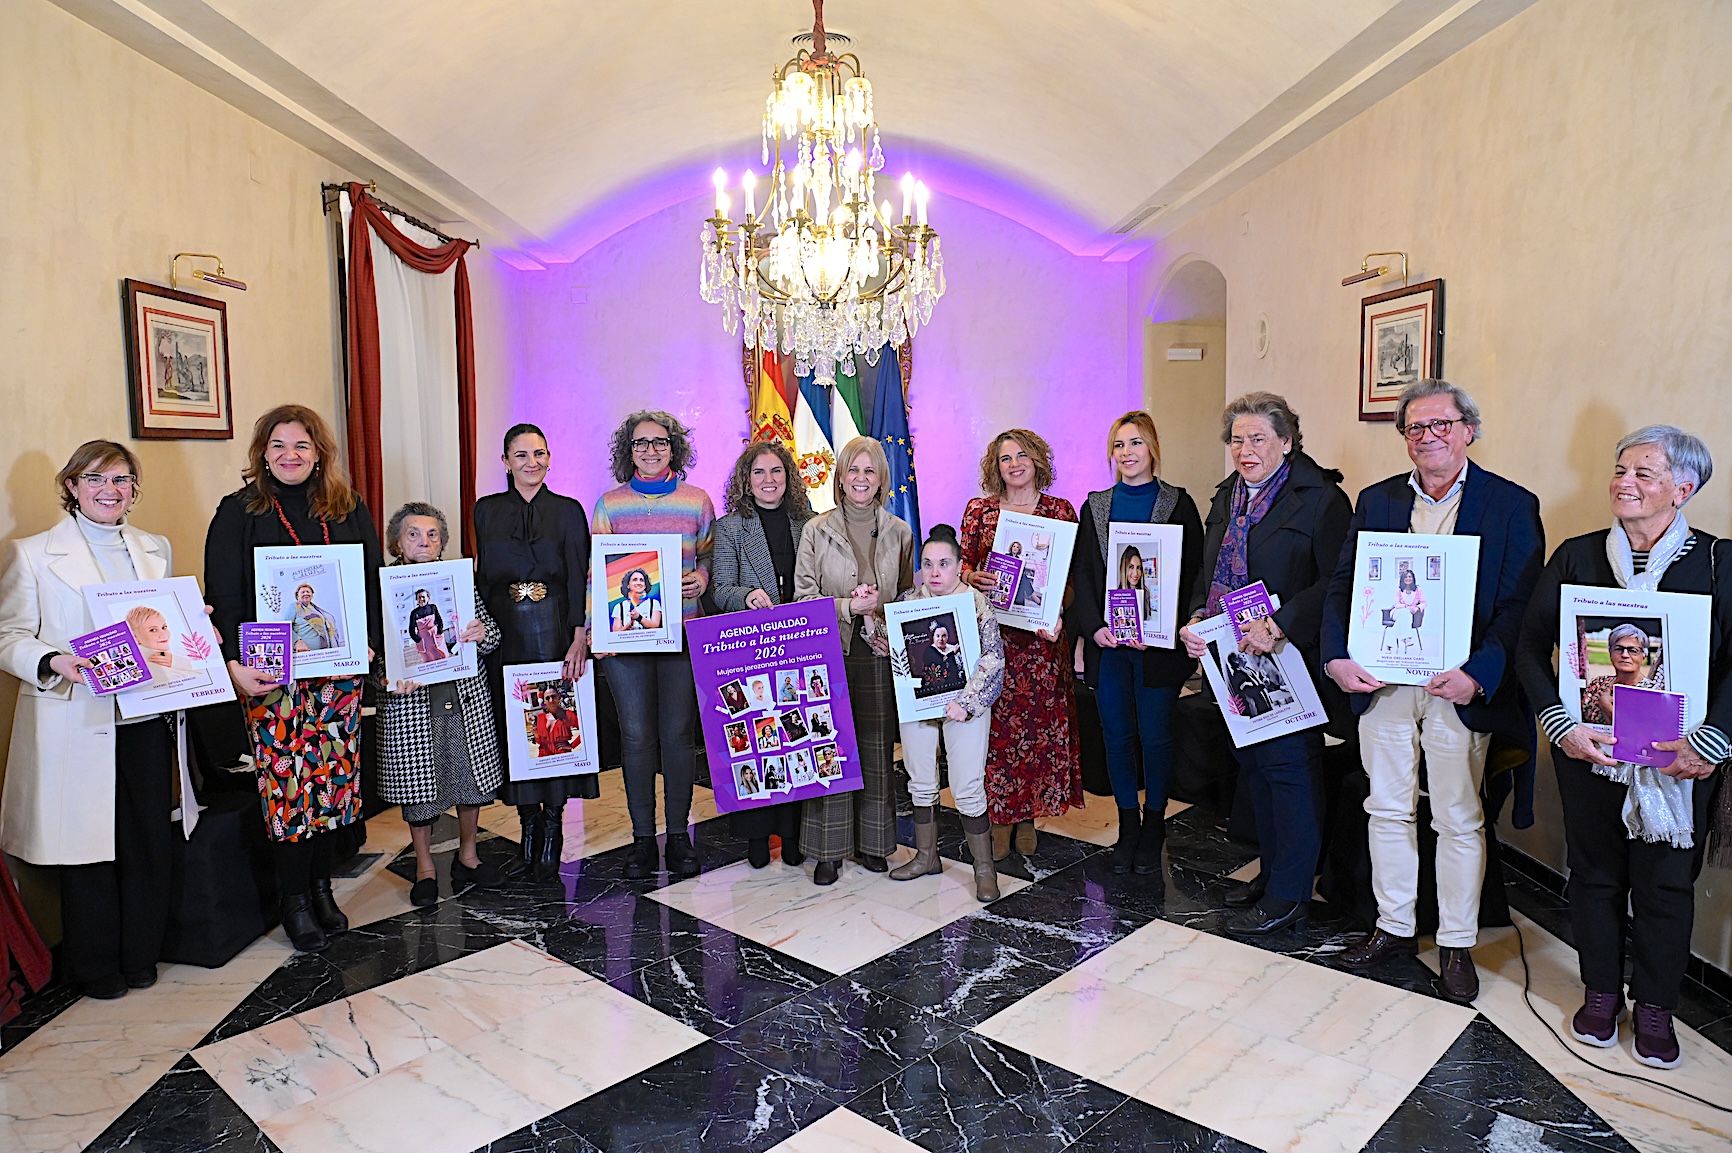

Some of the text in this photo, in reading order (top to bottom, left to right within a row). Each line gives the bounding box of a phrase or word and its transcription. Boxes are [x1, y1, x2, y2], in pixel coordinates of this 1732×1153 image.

[720, 617, 808, 639] AGENDA IGUALDAD
[1027, 619, 1050, 627] AGOSTO
[703, 640, 746, 654] Tributo
[759, 635, 776, 645] las
[779, 627, 829, 641] nuestras
[755, 644, 786, 660] 2026
[453, 665, 471, 673] ABRIL
[716, 666, 744, 677] Mujeres
[744, 661, 778, 673] jerezanas
[796, 652, 823, 663] historia
[1406, 668, 1444, 677] NOVIEM
[191, 688, 226, 698] FEBRERO
[1285, 711, 1317, 724] OCTUBRE
